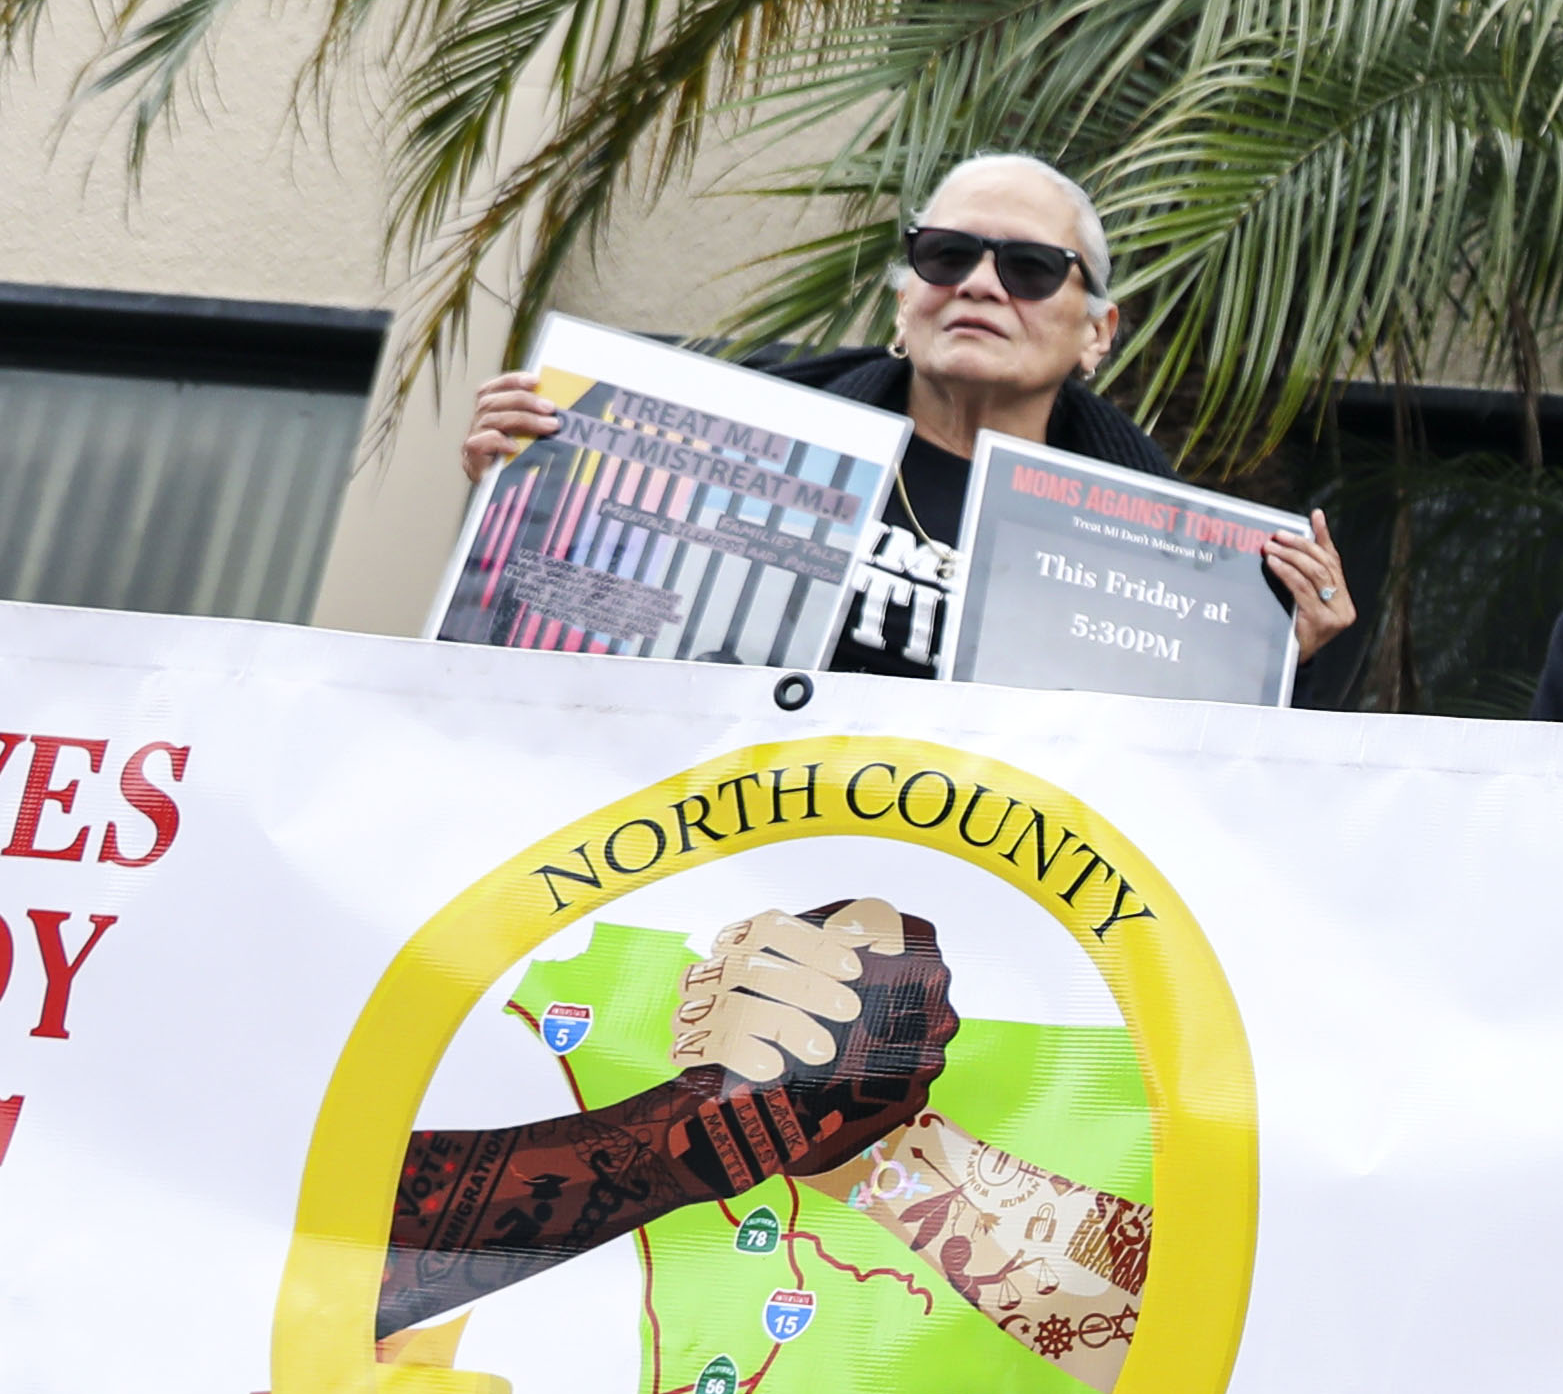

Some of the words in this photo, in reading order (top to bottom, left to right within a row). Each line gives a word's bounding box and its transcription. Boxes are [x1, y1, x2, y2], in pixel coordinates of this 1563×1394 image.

[621, 390, 720, 438] TREAT
[722, 425, 779, 459] M.I.
[555, 409, 627, 453] ON'T
[628, 431, 789, 499] MISTREAT
[792, 487, 849, 521] M.I.
[1010, 464, 1082, 507] MOMS
[1084, 482, 1181, 534] AGAINST
[1184, 509, 1277, 557] TORTUR
[1072, 515, 1103, 537] Treat
[1121, 526, 1150, 546] Don't
[1151, 535, 1196, 560] Mistreat
[1035, 550, 1098, 590] This
[1104, 568, 1197, 624] Friday
[1202, 599, 1232, 625] at
[1069, 612, 1182, 663] 5:30PM
[531, 762, 822, 916] NORTH
[843, 760, 1159, 945] COUNTY
[554, 1028, 571, 1047] 5
[762, 1086, 803, 1153] LACK
[398, 1134, 452, 1217] VOTE
[747, 1229, 768, 1248] 78
[774, 1315, 799, 1335] 15
